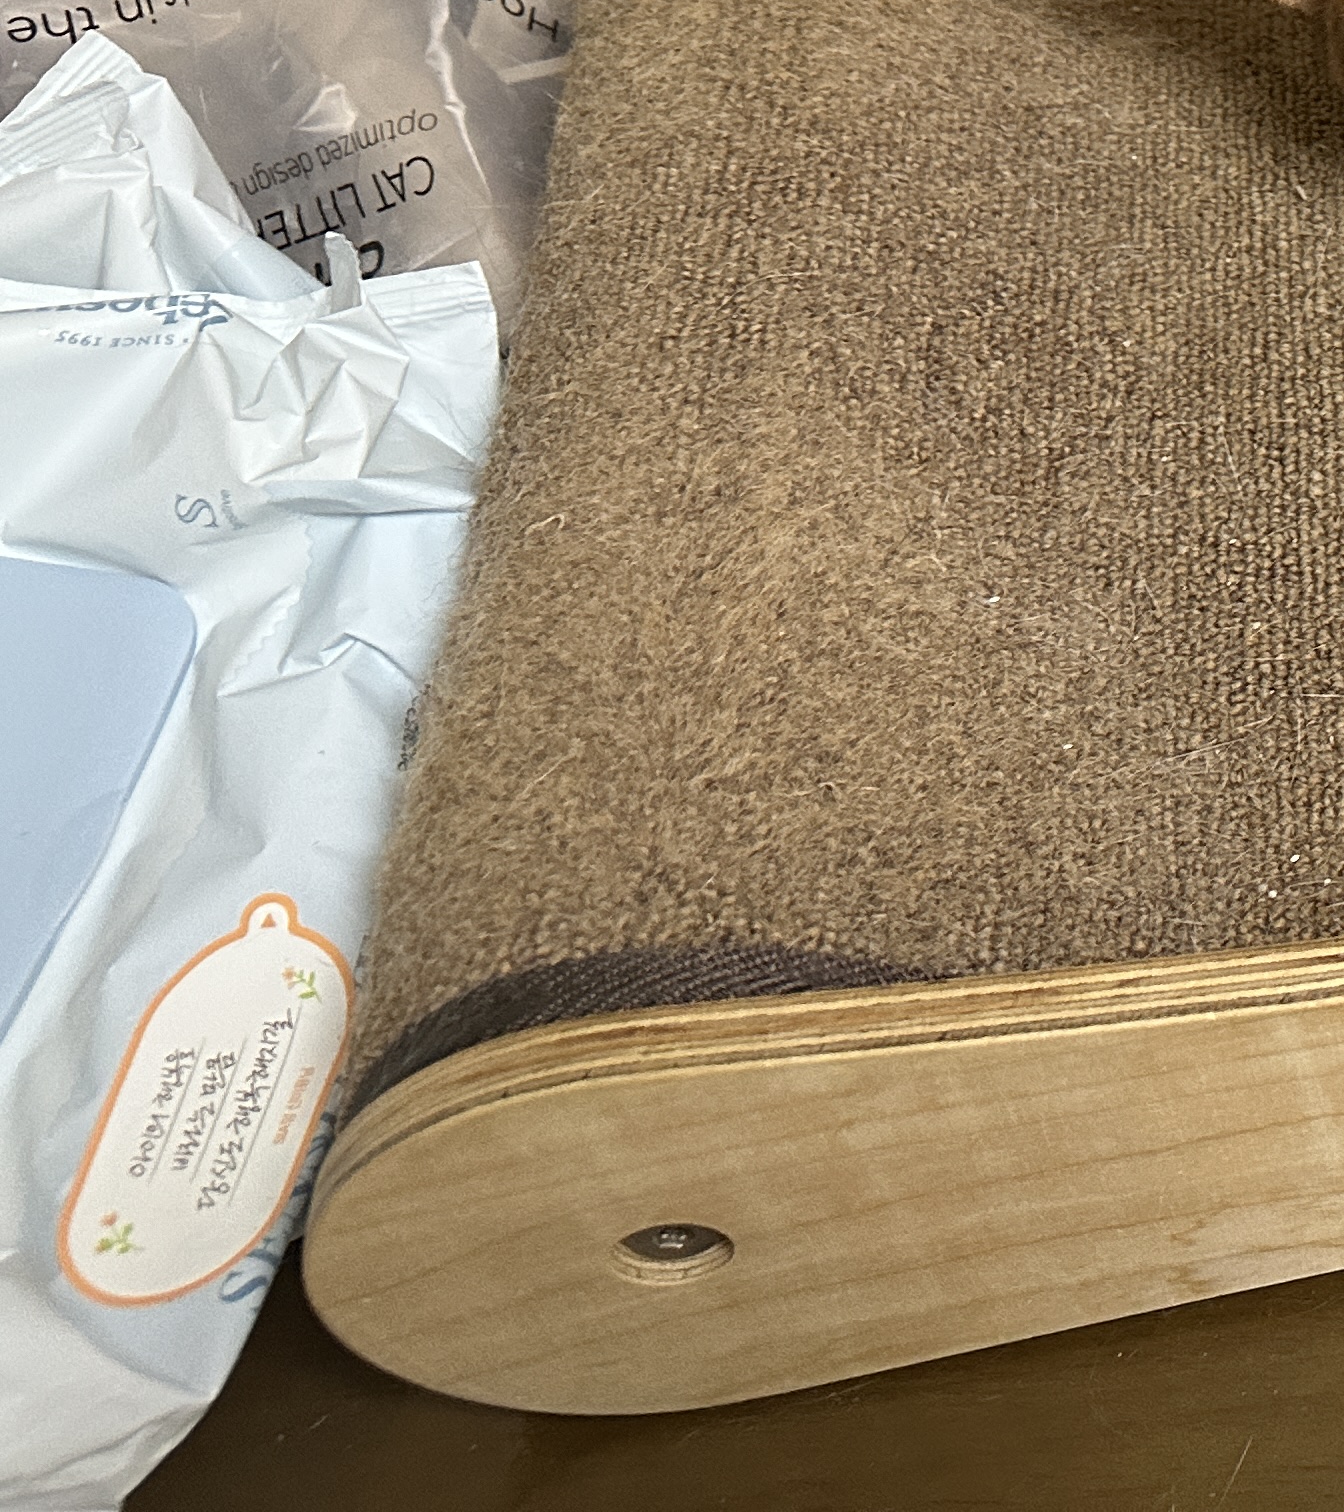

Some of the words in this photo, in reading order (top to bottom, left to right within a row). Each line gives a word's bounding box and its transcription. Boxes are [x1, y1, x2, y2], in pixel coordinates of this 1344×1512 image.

[6, 6, 100, 44] the
[314, 108, 438, 171] optimized
[242, 151, 314, 196] design
[371, 155, 435, 213] CAT
[54, 329, 103, 348] 1995
[108, 333, 175, 348] SINCE
